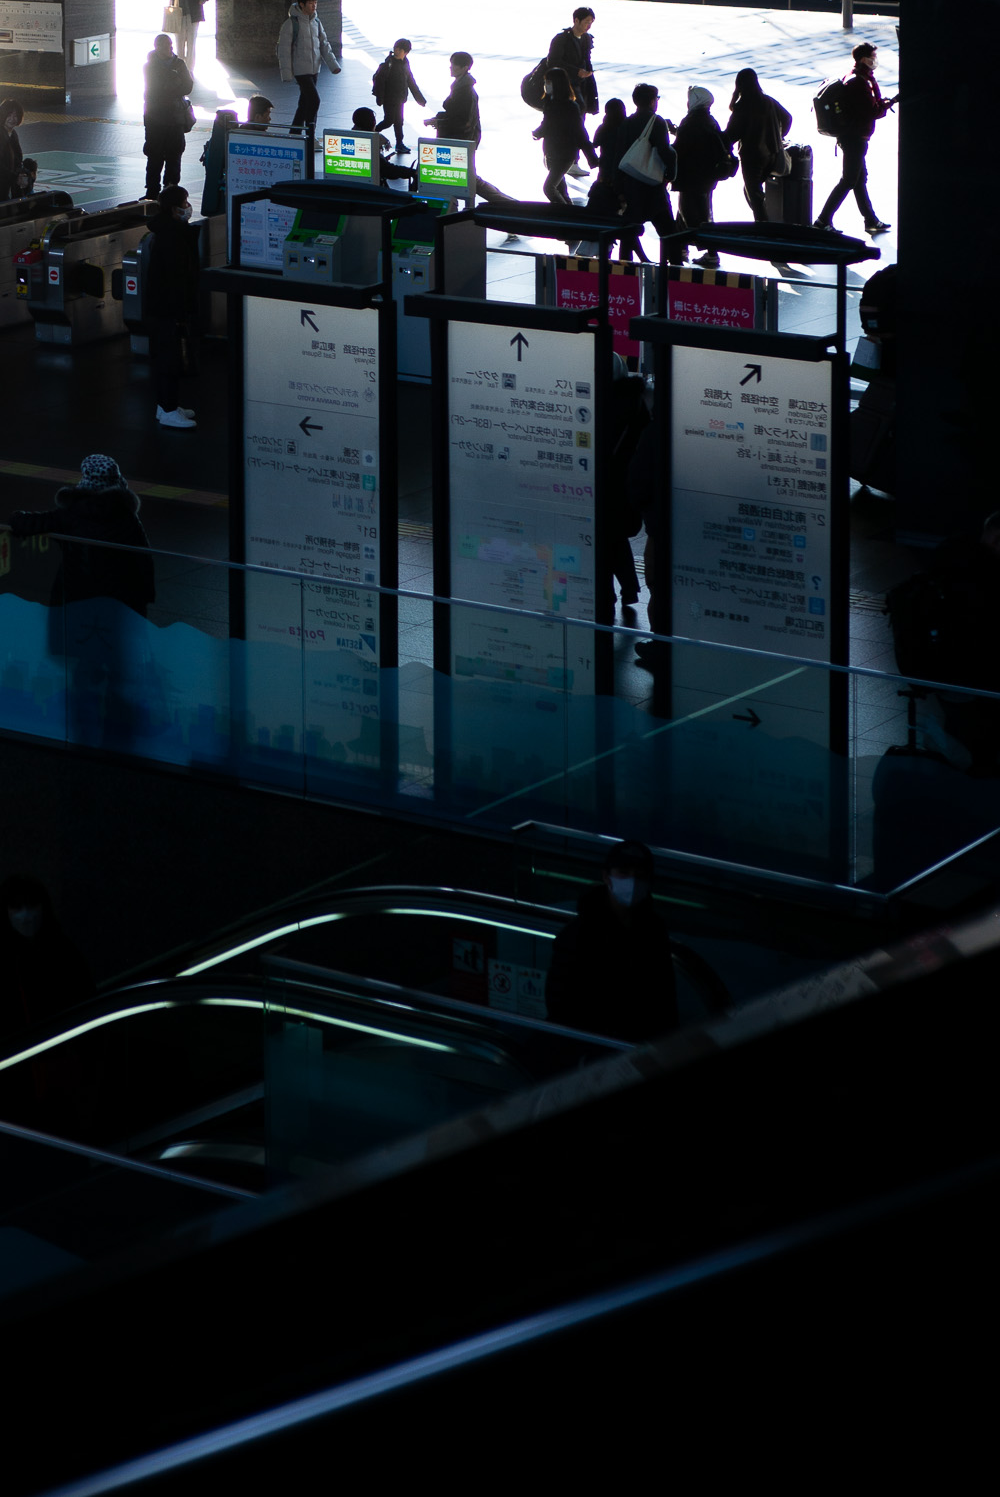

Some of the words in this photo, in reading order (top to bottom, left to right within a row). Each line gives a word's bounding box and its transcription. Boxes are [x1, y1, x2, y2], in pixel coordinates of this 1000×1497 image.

[327, 159, 370, 170] きっぷ受取専用
[422, 168, 466, 179] きっぷ受取専用
[561, 289, 635, 305] 柵にもたかから
[673, 300, 750, 318] 柵にもたれかから
